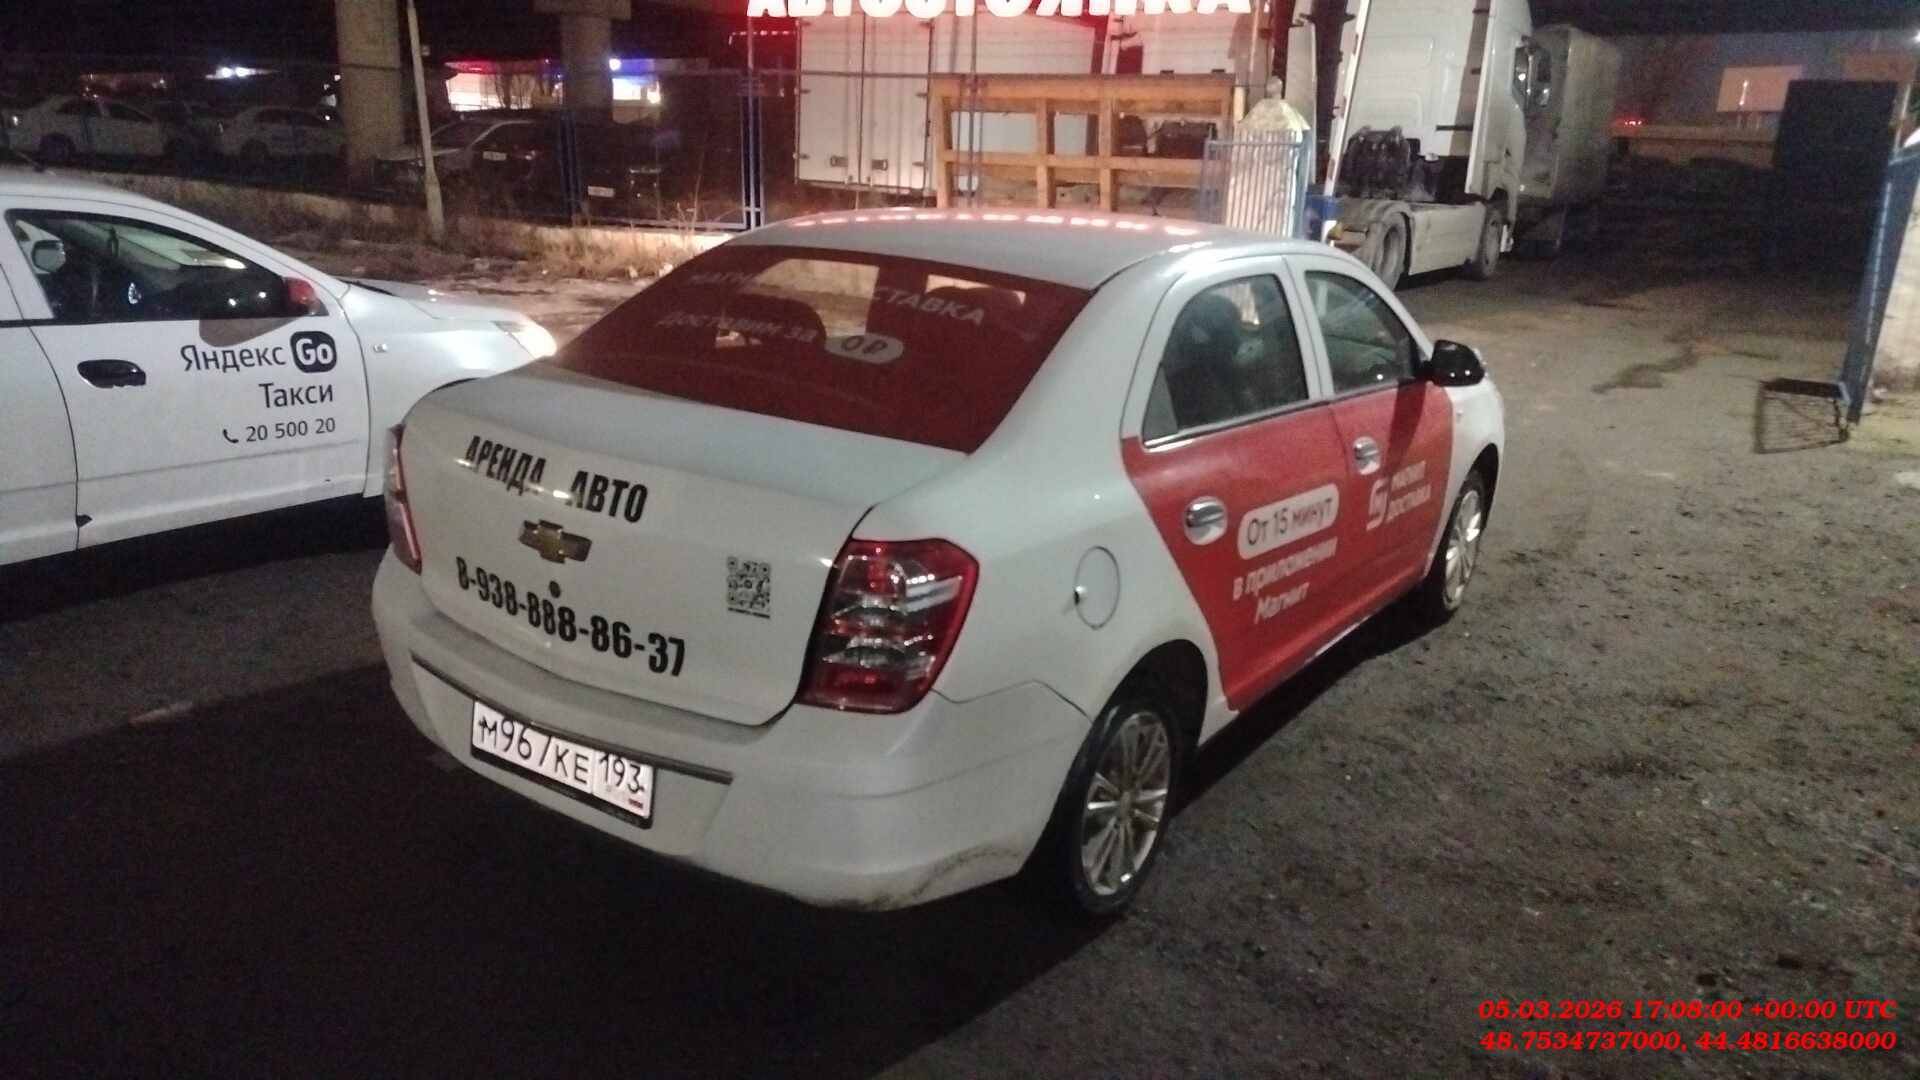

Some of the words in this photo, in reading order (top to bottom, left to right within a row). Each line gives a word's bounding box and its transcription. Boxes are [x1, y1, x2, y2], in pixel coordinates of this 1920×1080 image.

[180, 344, 287, 373] Яндекс
[295, 338, 335, 366] Go
[258, 382, 334, 409] Такси
[246, 424, 269, 442] 20
[275, 420, 309, 440] 500
[315, 417, 337, 435] 20
[464, 435, 547, 496] АРЕНДА
[565, 470, 649, 524] АВТО
[1247, 516, 1270, 546] От
[1273, 507, 1289, 535] 15
[455, 556, 686, 677] 8-938-888-86-37
